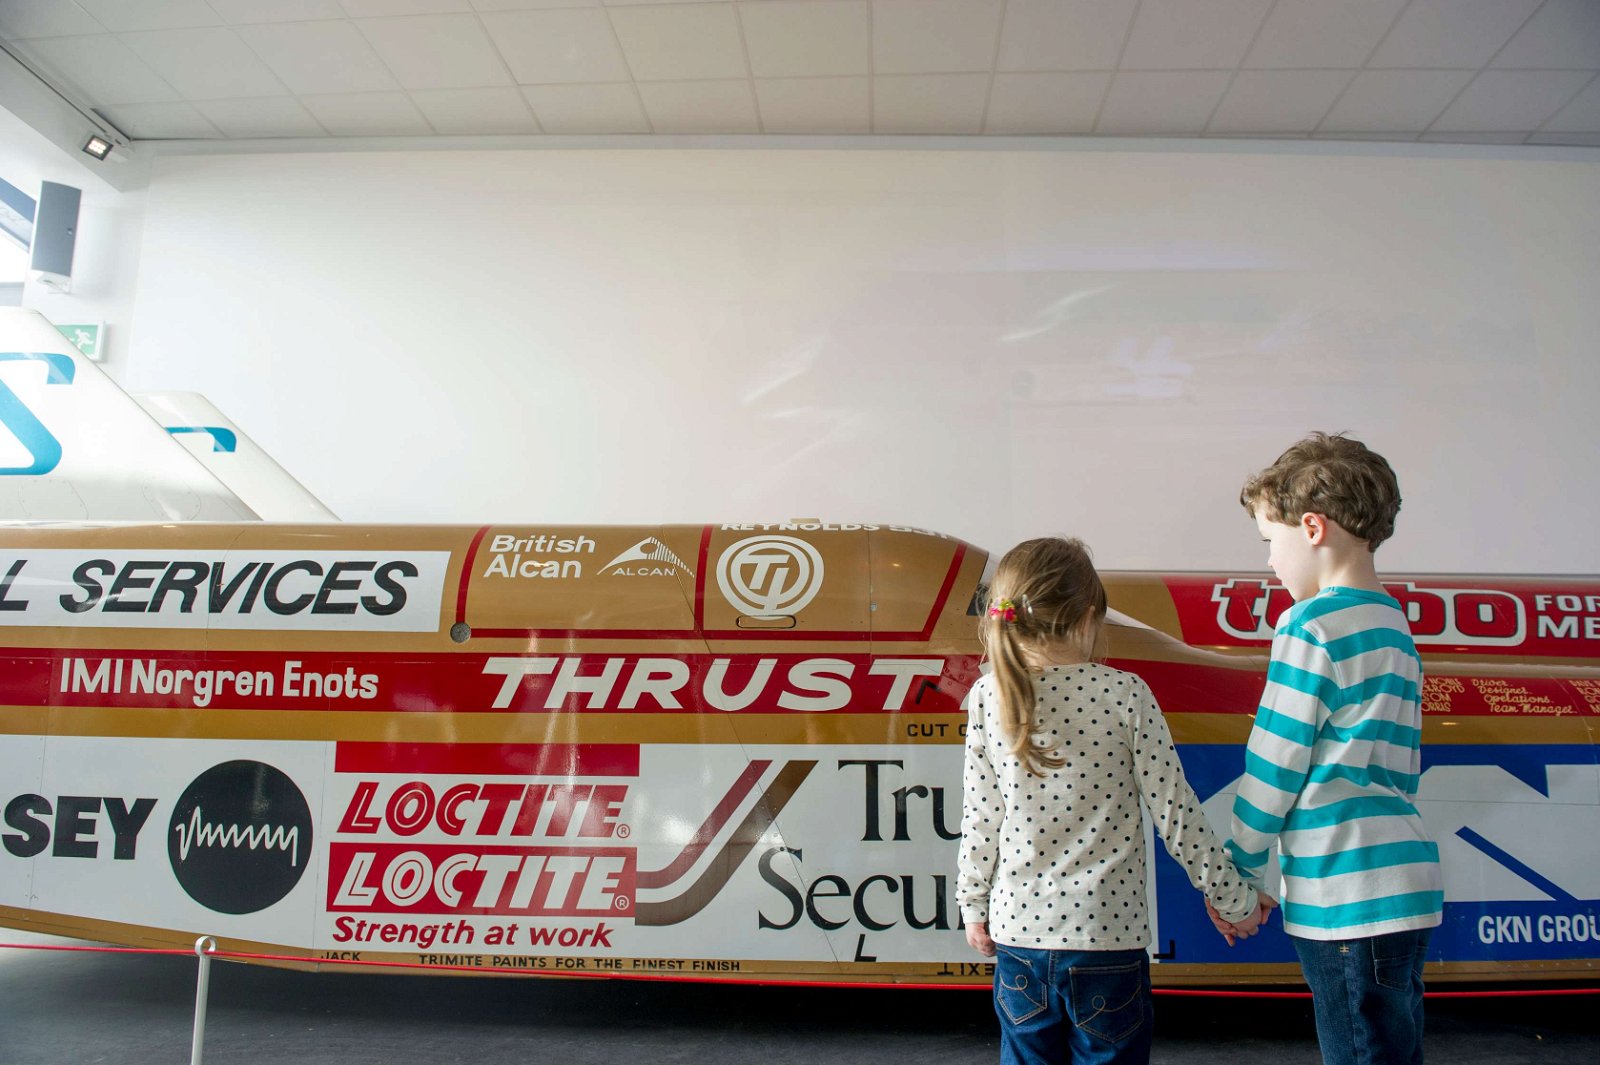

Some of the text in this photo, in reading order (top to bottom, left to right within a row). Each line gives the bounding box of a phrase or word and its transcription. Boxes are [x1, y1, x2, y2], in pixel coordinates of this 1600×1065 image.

[720, 523, 880, 532] REYNOLDS
[489, 534, 596, 553] British
[482, 553, 583, 579] Alcan
[611, 566, 676, 577] ALCAN
[59, 558, 419, 615] SERVICES
[1210, 578, 1528, 648] tubo
[60, 657, 379, 708] IMI Norgren Enots
[481, 656, 946, 712] THRUST
[1488, 702, 1519, 713] Team
[907, 723, 949, 737] CUT
[336, 781, 629, 838] LOCTITE
[1, 793, 159, 860] SEY
[332, 850, 627, 909] LOCTITE
[758, 846, 965, 932] Secu
[332, 915, 615, 949] Strength at work
[1478, 915, 1533, 944] GKN
[321, 951, 361, 961] JACK
[419, 954, 741, 971] TRIMITE PAINTS FOR THE FINEST FINISH
